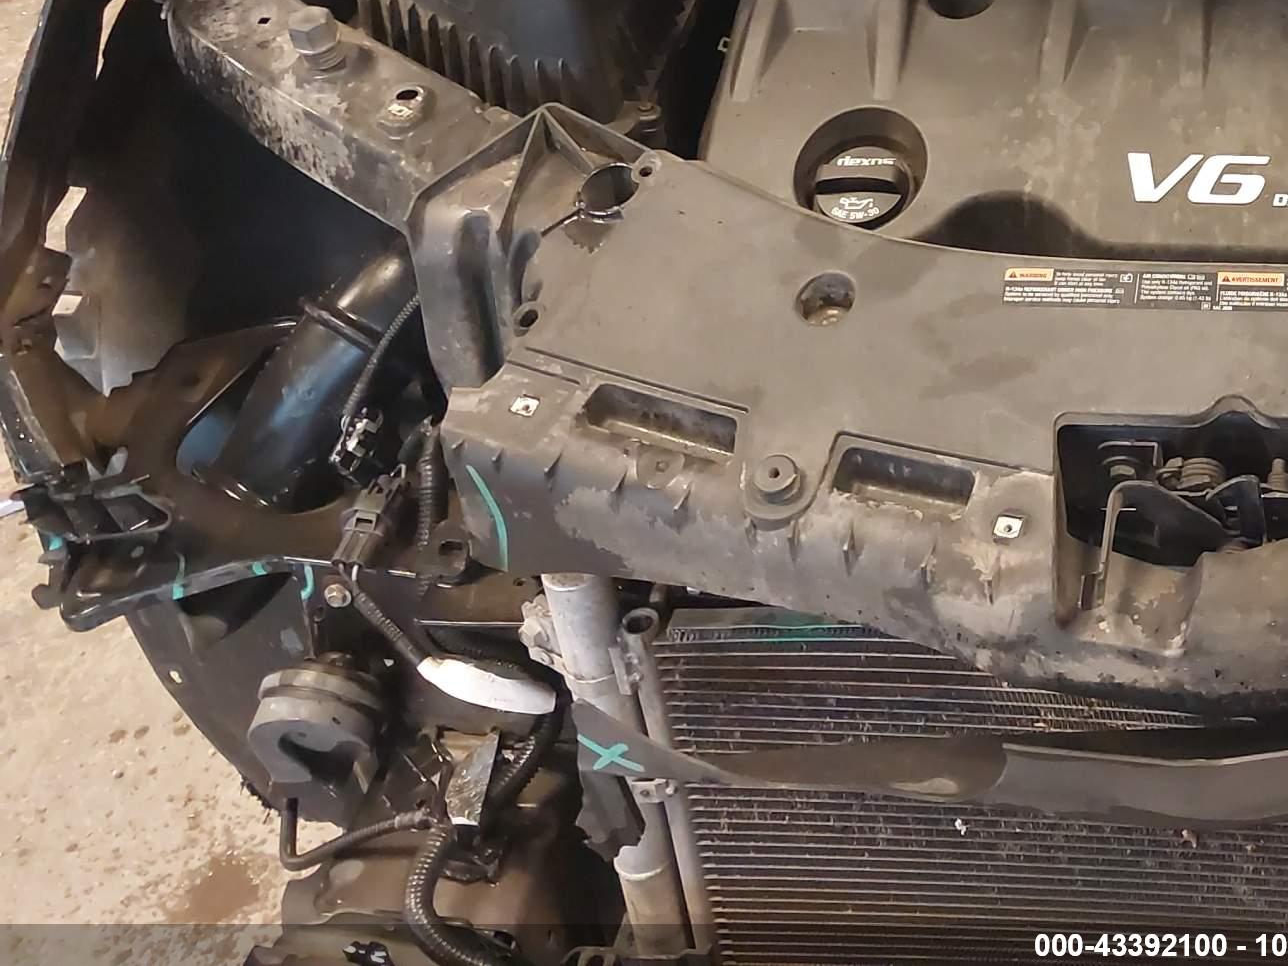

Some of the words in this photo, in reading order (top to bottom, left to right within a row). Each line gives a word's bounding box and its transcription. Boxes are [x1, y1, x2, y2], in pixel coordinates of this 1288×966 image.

[1127, 152, 1272, 205] V6
[831, 207, 848, 219] SAE
[849, 207, 880, 220] 5W-30
